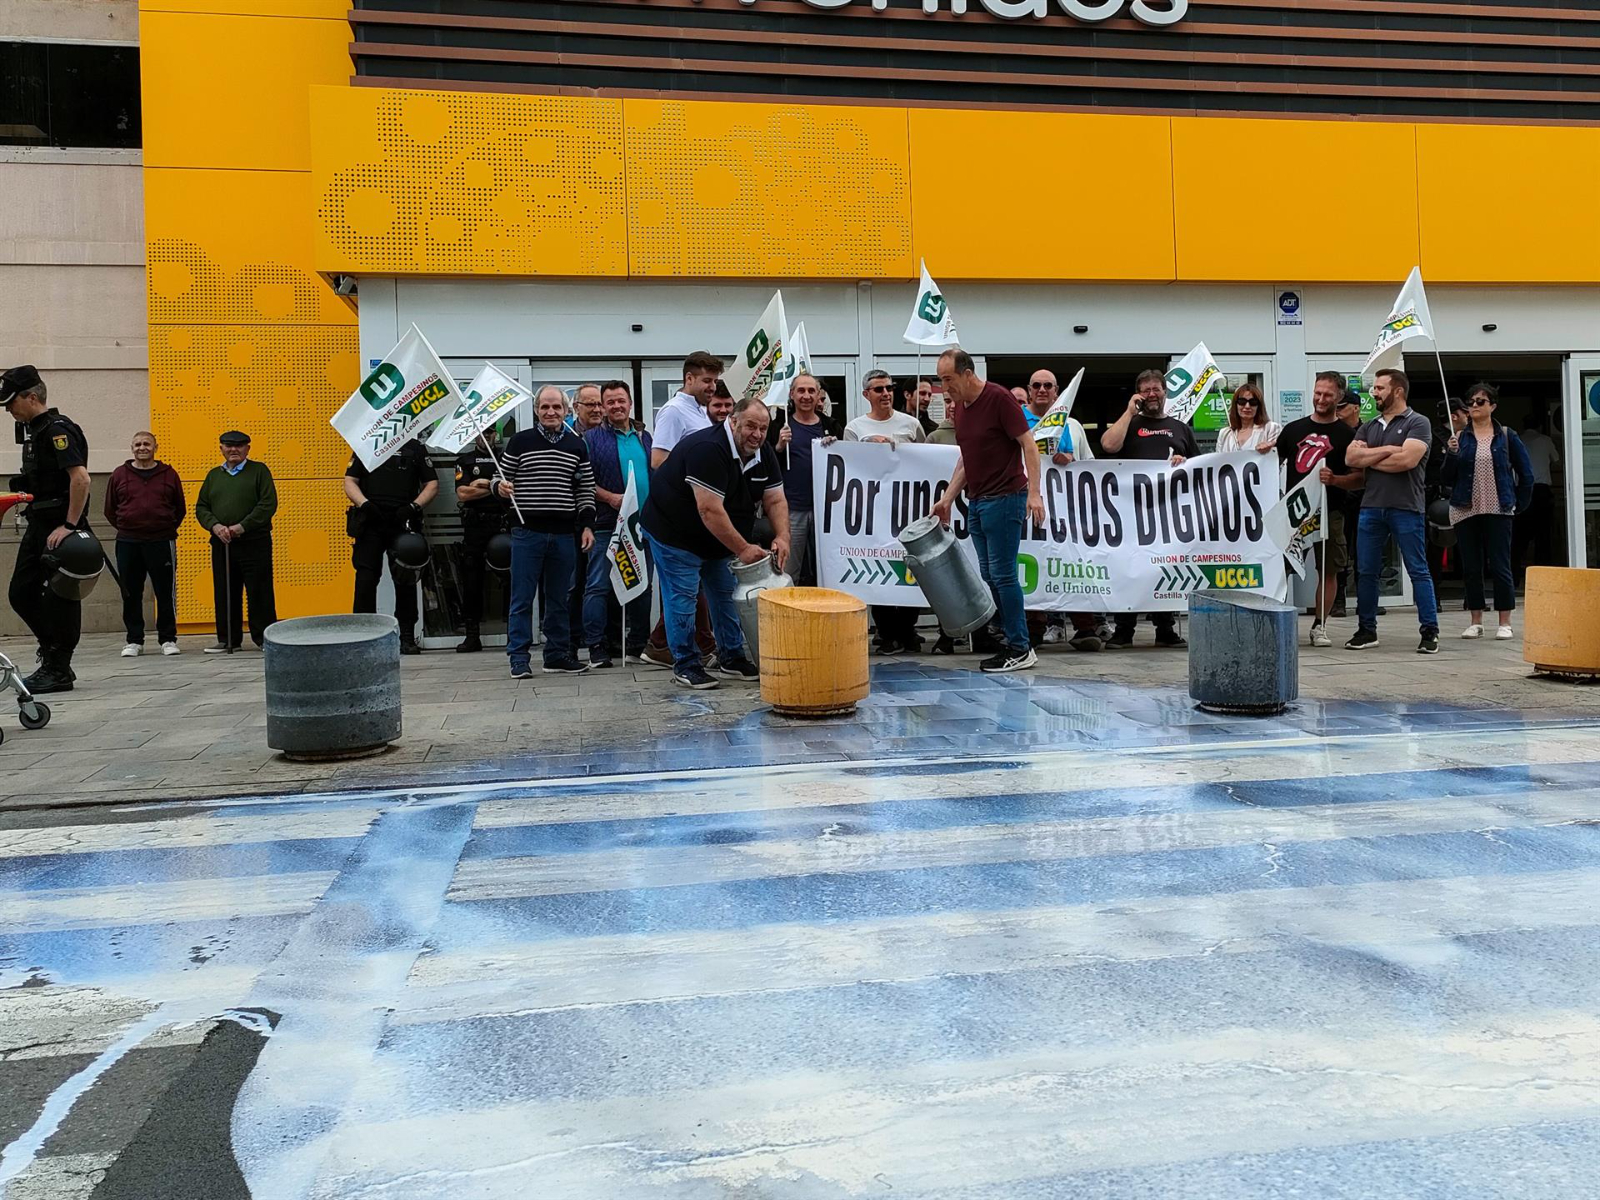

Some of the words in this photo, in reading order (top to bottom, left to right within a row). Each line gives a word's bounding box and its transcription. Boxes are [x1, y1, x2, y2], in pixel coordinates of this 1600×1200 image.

[1282, 298, 1296, 307] ADT
[361, 419, 384, 442] UNION
[382, 408, 394, 421] DE
[393, 372, 439, 411] CAMPESINOS
[410, 385, 445, 415] UCCL
[486, 391, 516, 412] UCCL
[374, 437, 401, 458] Castilla
[823, 453, 881, 536] Por
[1133, 461, 1264, 546] DIGNOS
[840, 546, 866, 557] UNION
[866, 548, 879, 558] DE
[1150, 555, 1178, 565] UNION
[1179, 554, 1190, 564] DE
[1191, 554, 1242, 564] CAMPESINOS
[614, 550, 636, 587] UCCL
[1046, 557, 1111, 581] Unión
[1214, 567, 1259, 588] UCCL
[1045, 581, 1060, 594] de
[1062, 582, 1112, 596] Uniones
[1153, 591, 1183, 600] Castilla
